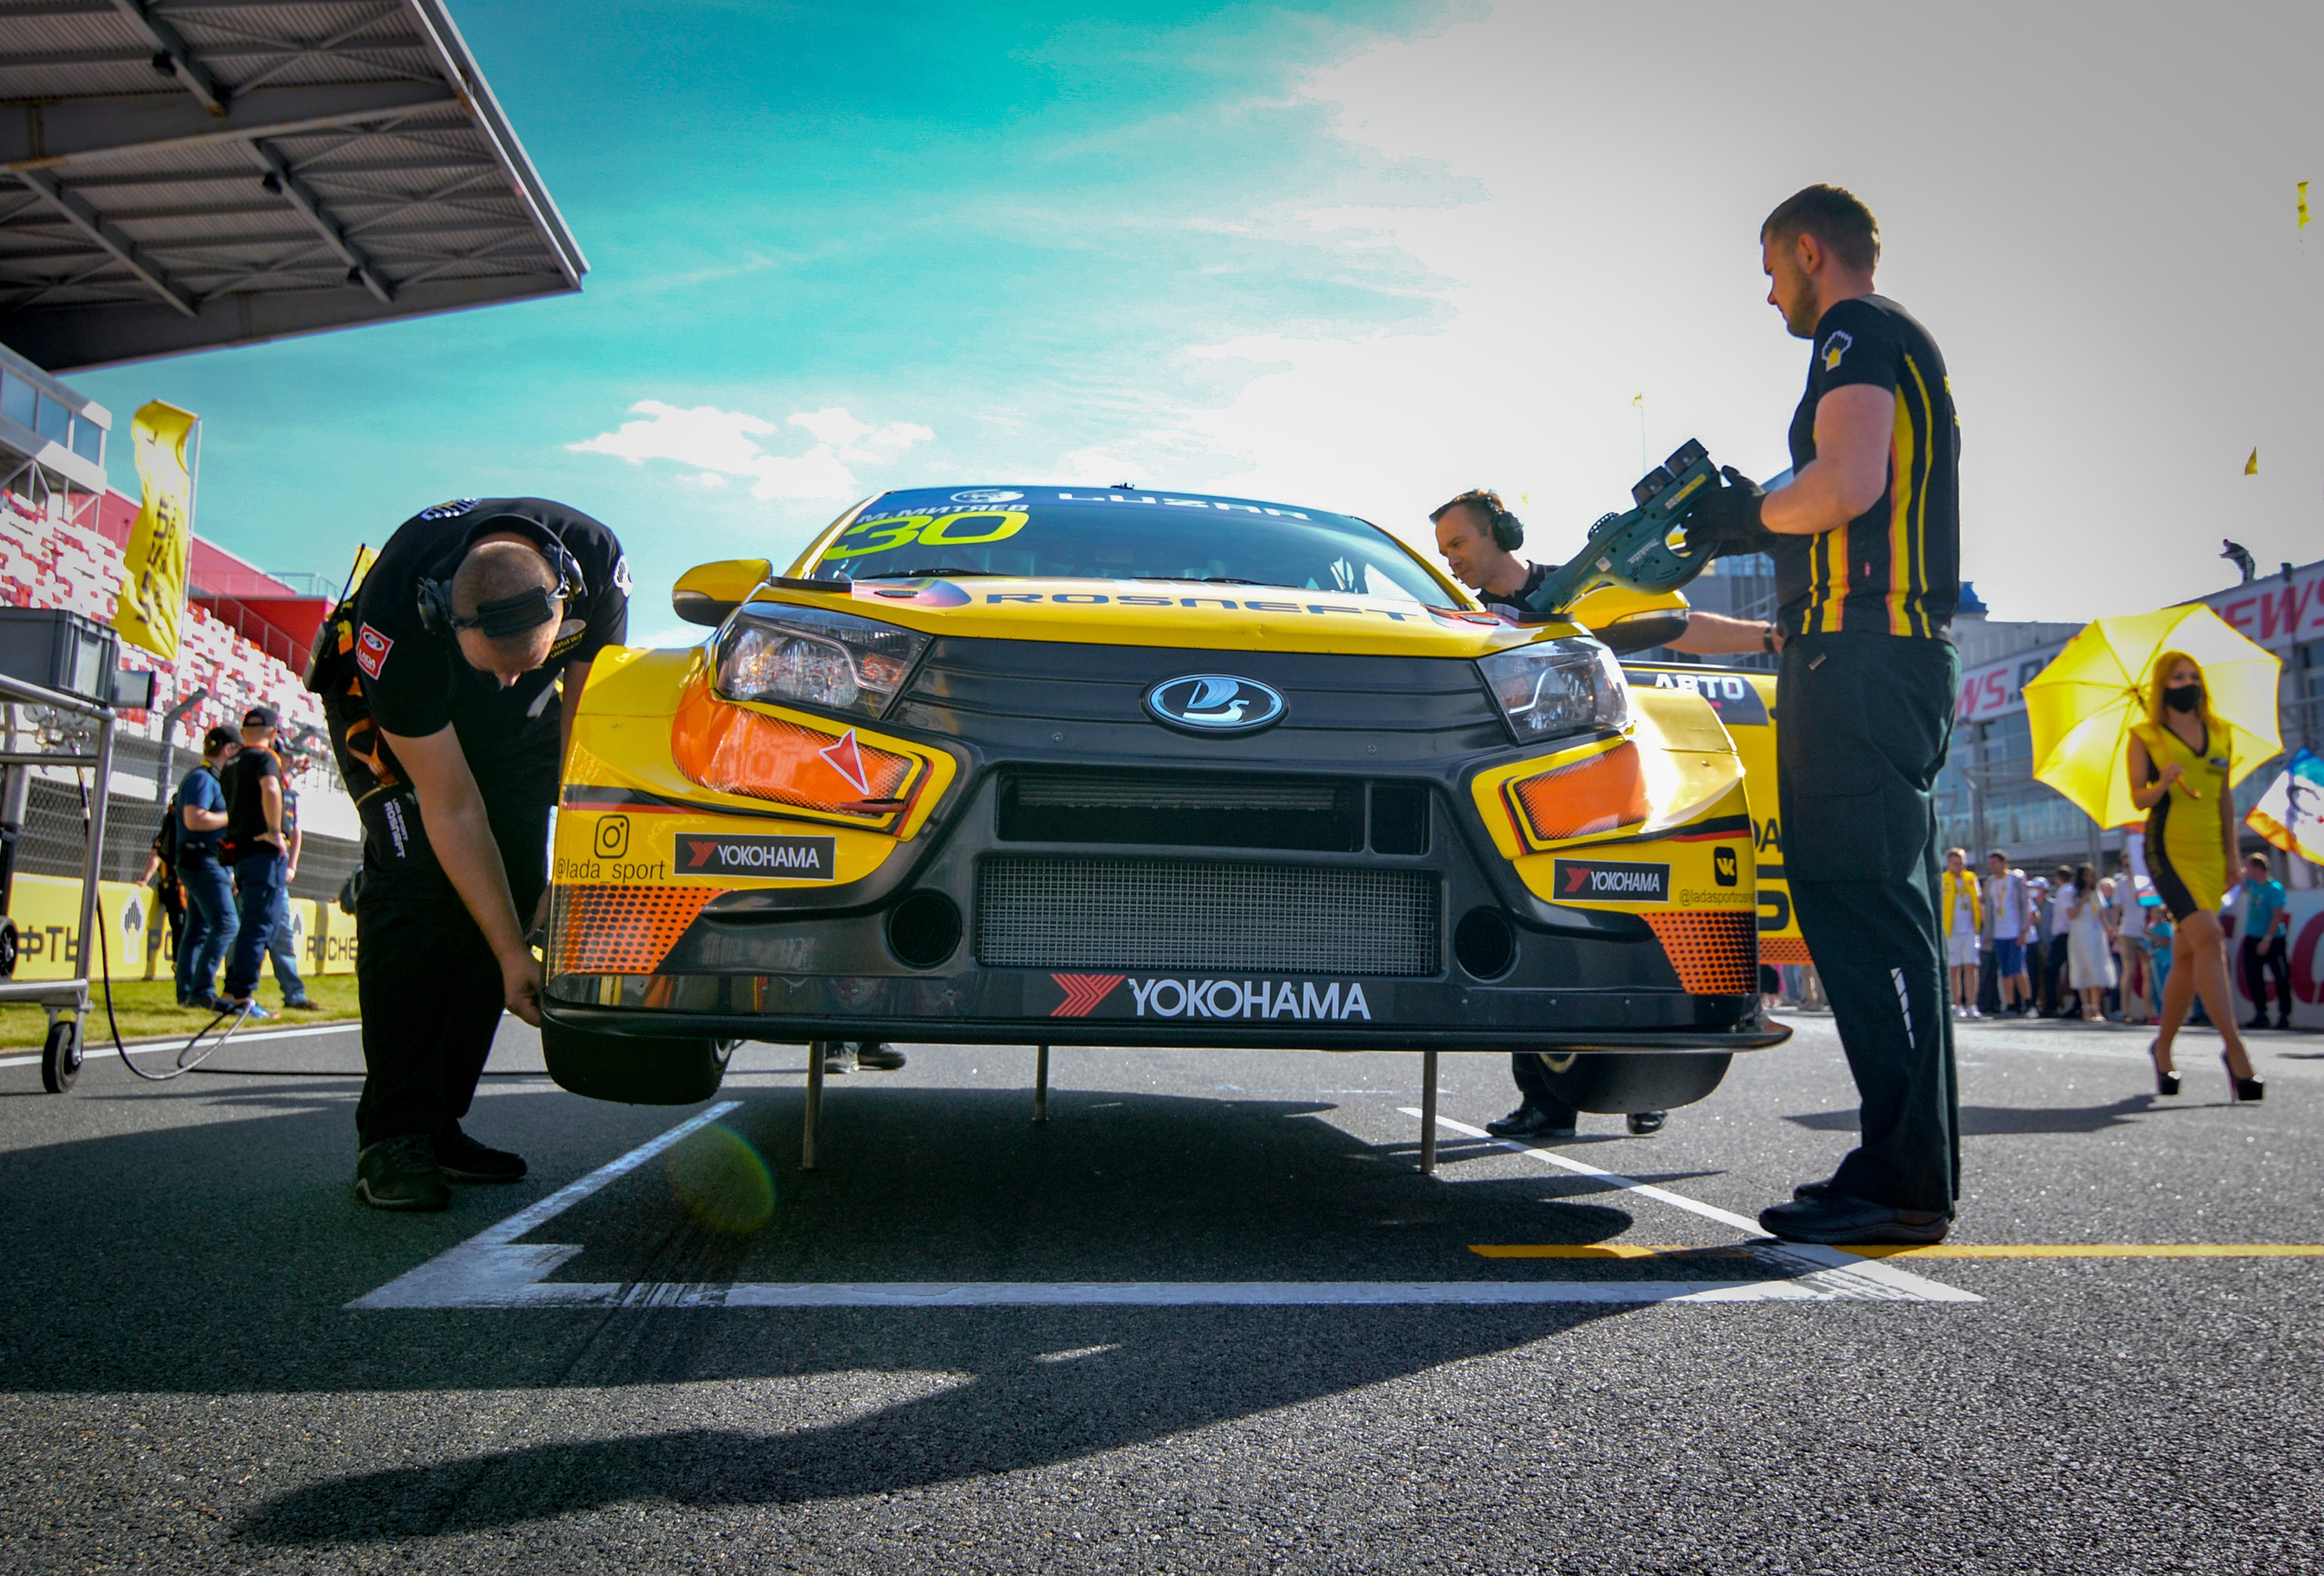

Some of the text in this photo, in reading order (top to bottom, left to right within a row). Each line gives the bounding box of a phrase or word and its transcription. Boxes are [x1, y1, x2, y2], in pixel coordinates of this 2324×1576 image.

[1058, 492, 1313, 521] LUZAR
[822, 510, 1030, 560] 30
[985, 592, 1420, 622] ROSNEFT
[555, 858, 665, 884] @lada_sport
[717, 844, 821, 870] YOKOHAMA
[1590, 871, 1660, 892] YOKOHAMA
[1127, 979, 1373, 1020] YOKOHAMA
